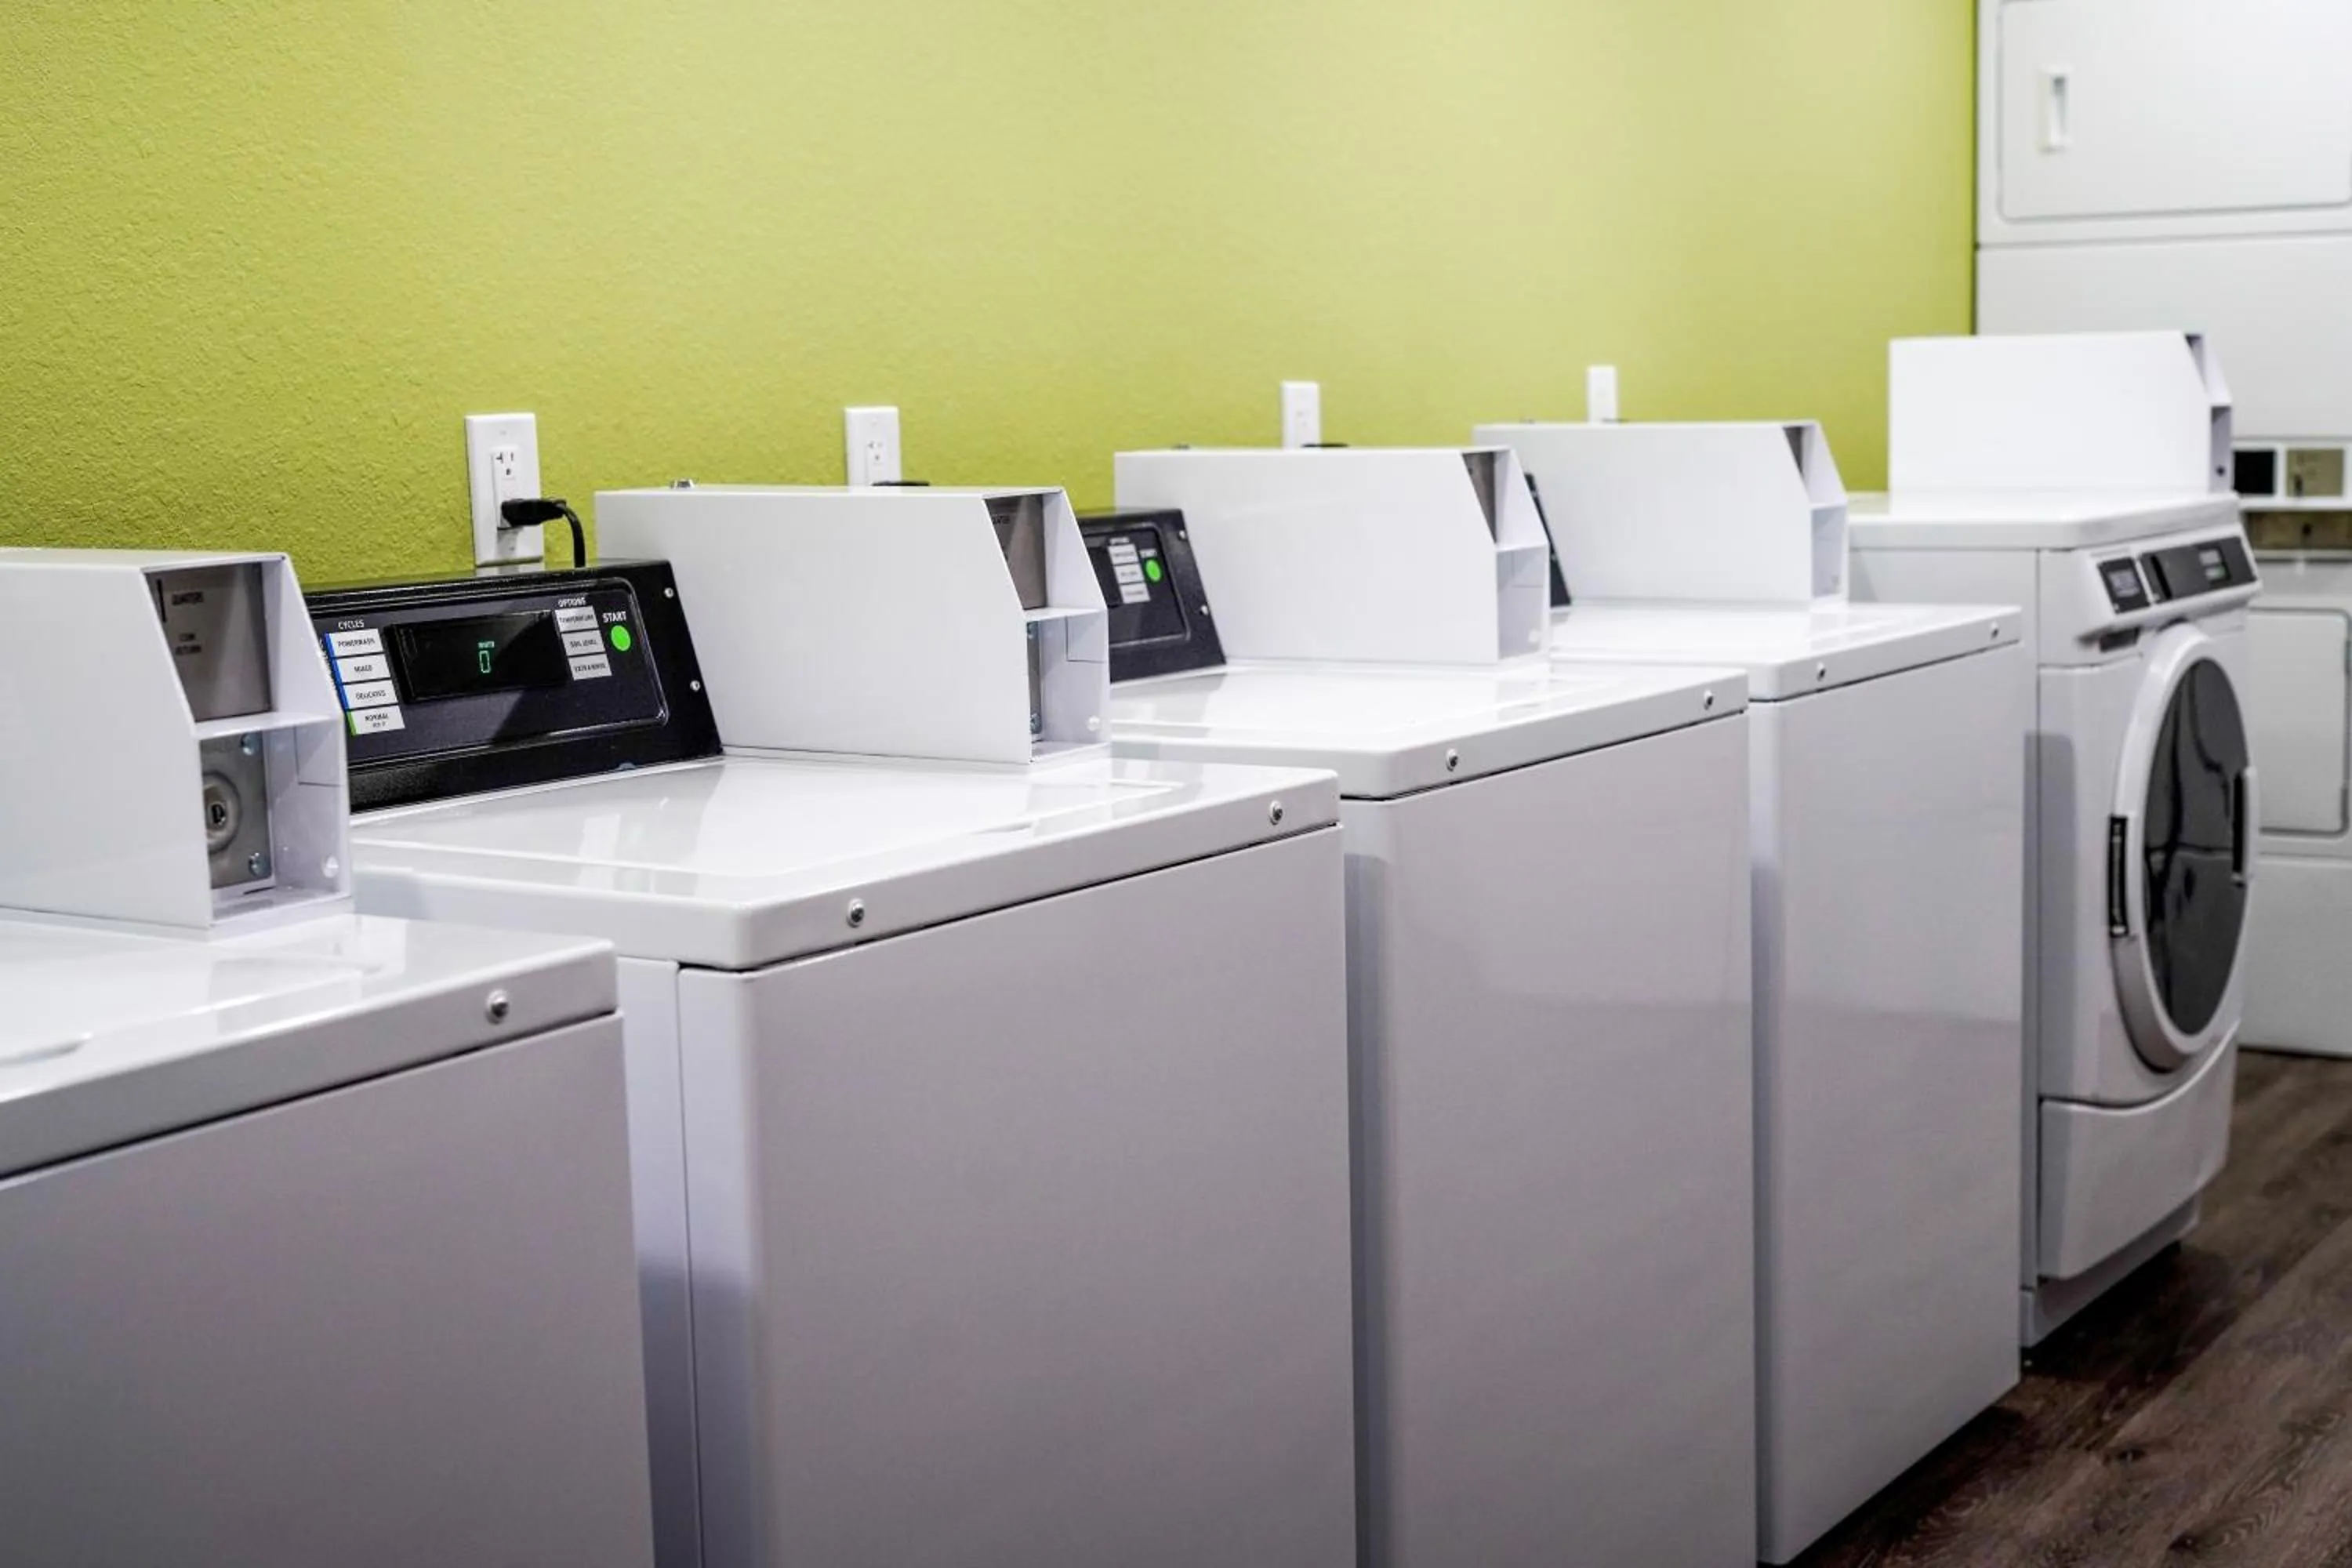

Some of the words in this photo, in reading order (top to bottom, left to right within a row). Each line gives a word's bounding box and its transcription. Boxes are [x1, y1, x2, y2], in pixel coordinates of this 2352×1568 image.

[557, 597, 586, 607] OPTIONS
[602, 612, 626, 622] START
[338, 619, 365, 630] CYCLES
[338, 637, 376, 648] POWERWASH
[365, 713, 389, 722] NORMAL
